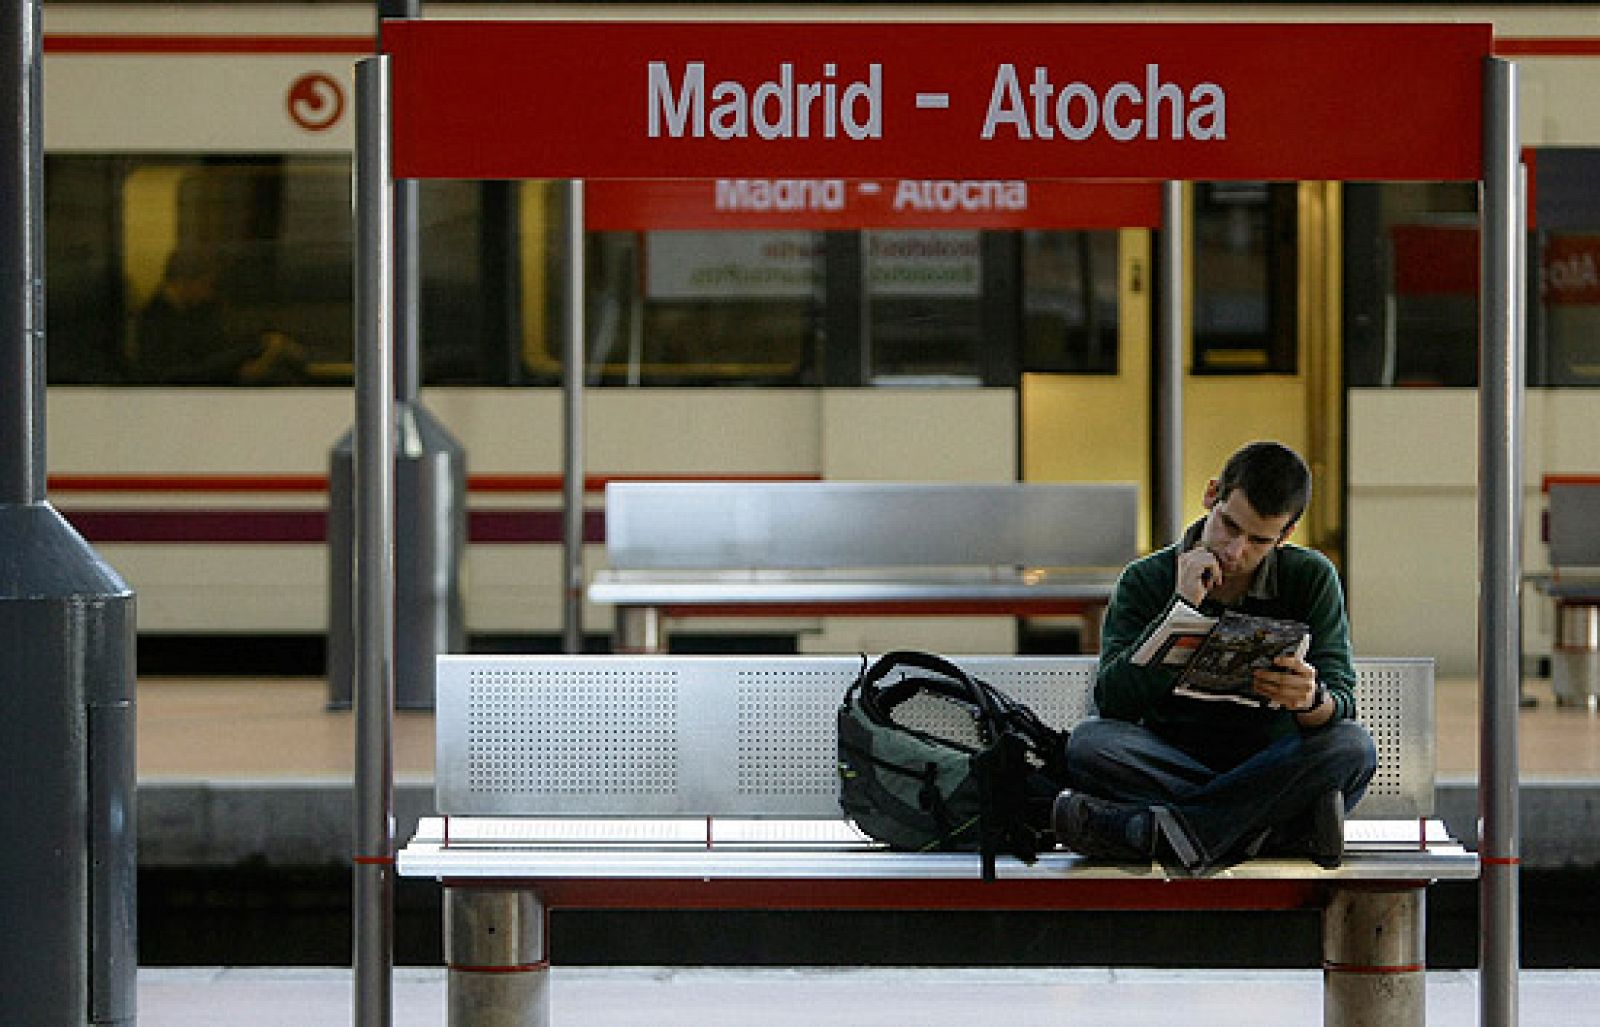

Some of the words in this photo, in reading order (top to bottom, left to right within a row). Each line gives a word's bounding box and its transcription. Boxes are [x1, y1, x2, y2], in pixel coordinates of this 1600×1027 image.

[647, 61, 882, 140] Madrid
[915, 92, 949, 108] -
[980, 63, 1226, 141] Atocha
